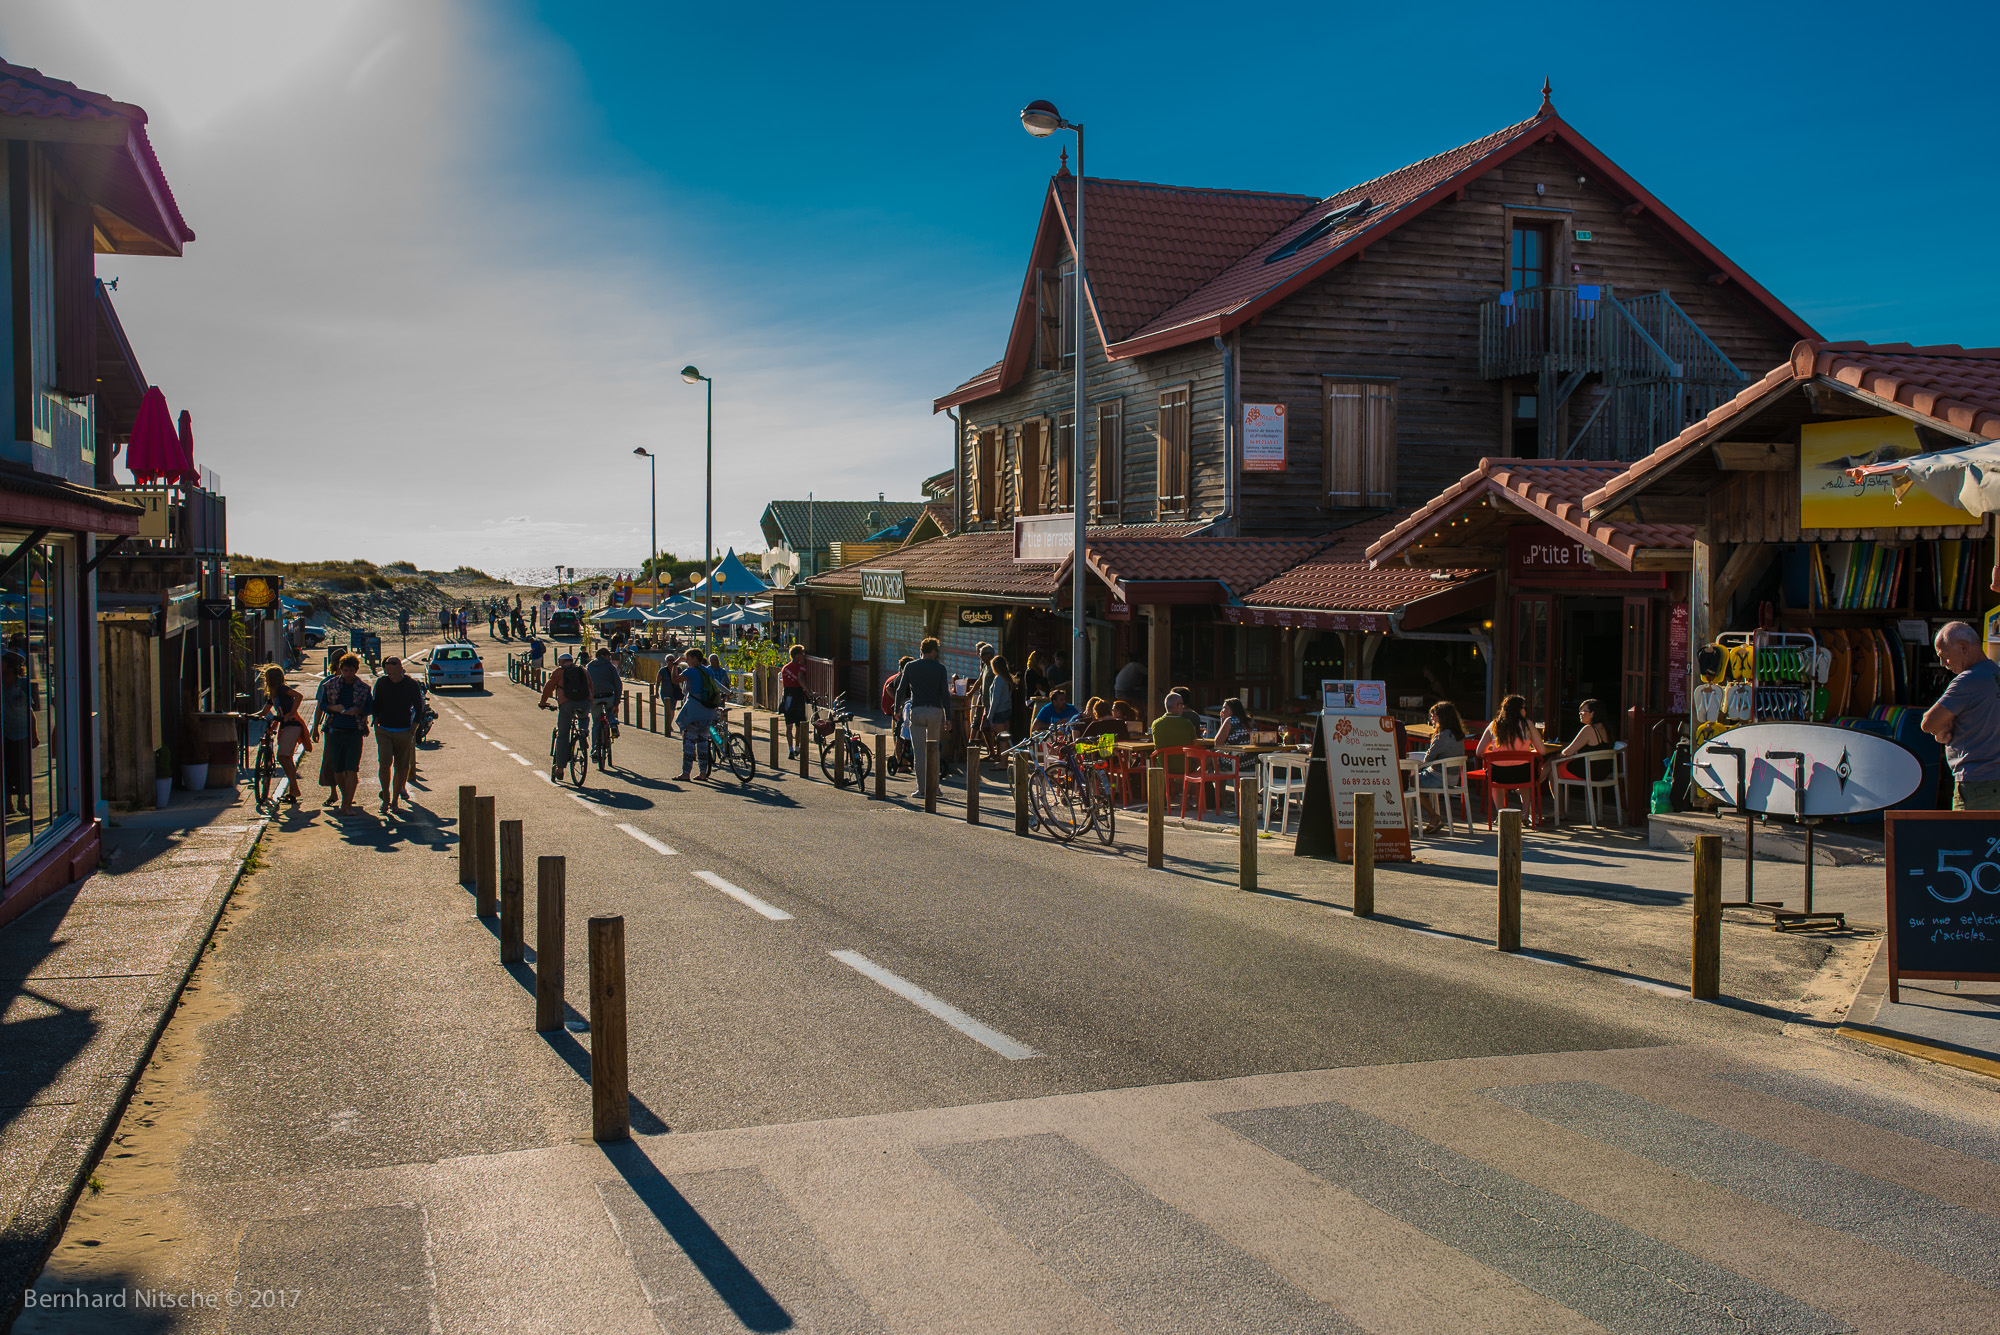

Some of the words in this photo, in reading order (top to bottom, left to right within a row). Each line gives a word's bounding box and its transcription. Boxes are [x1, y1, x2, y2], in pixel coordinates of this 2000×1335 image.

[1043, 531, 1074, 547] Terrass
[1523, 556, 1531, 564] La
[1530, 544, 1569, 564] P'tite
[863, 574, 884, 597] GOOD
[885, 575, 902, 598] SHOP
[961, 610, 993, 624] Carlsberg
[1352, 728, 1379, 738] Maeva
[1345, 736, 1360, 746] Spa
[1341, 753, 1387, 767] Ouvert
[1909, 918, 1926, 928] sur
[1960, 912, 2000, 926] selecti
